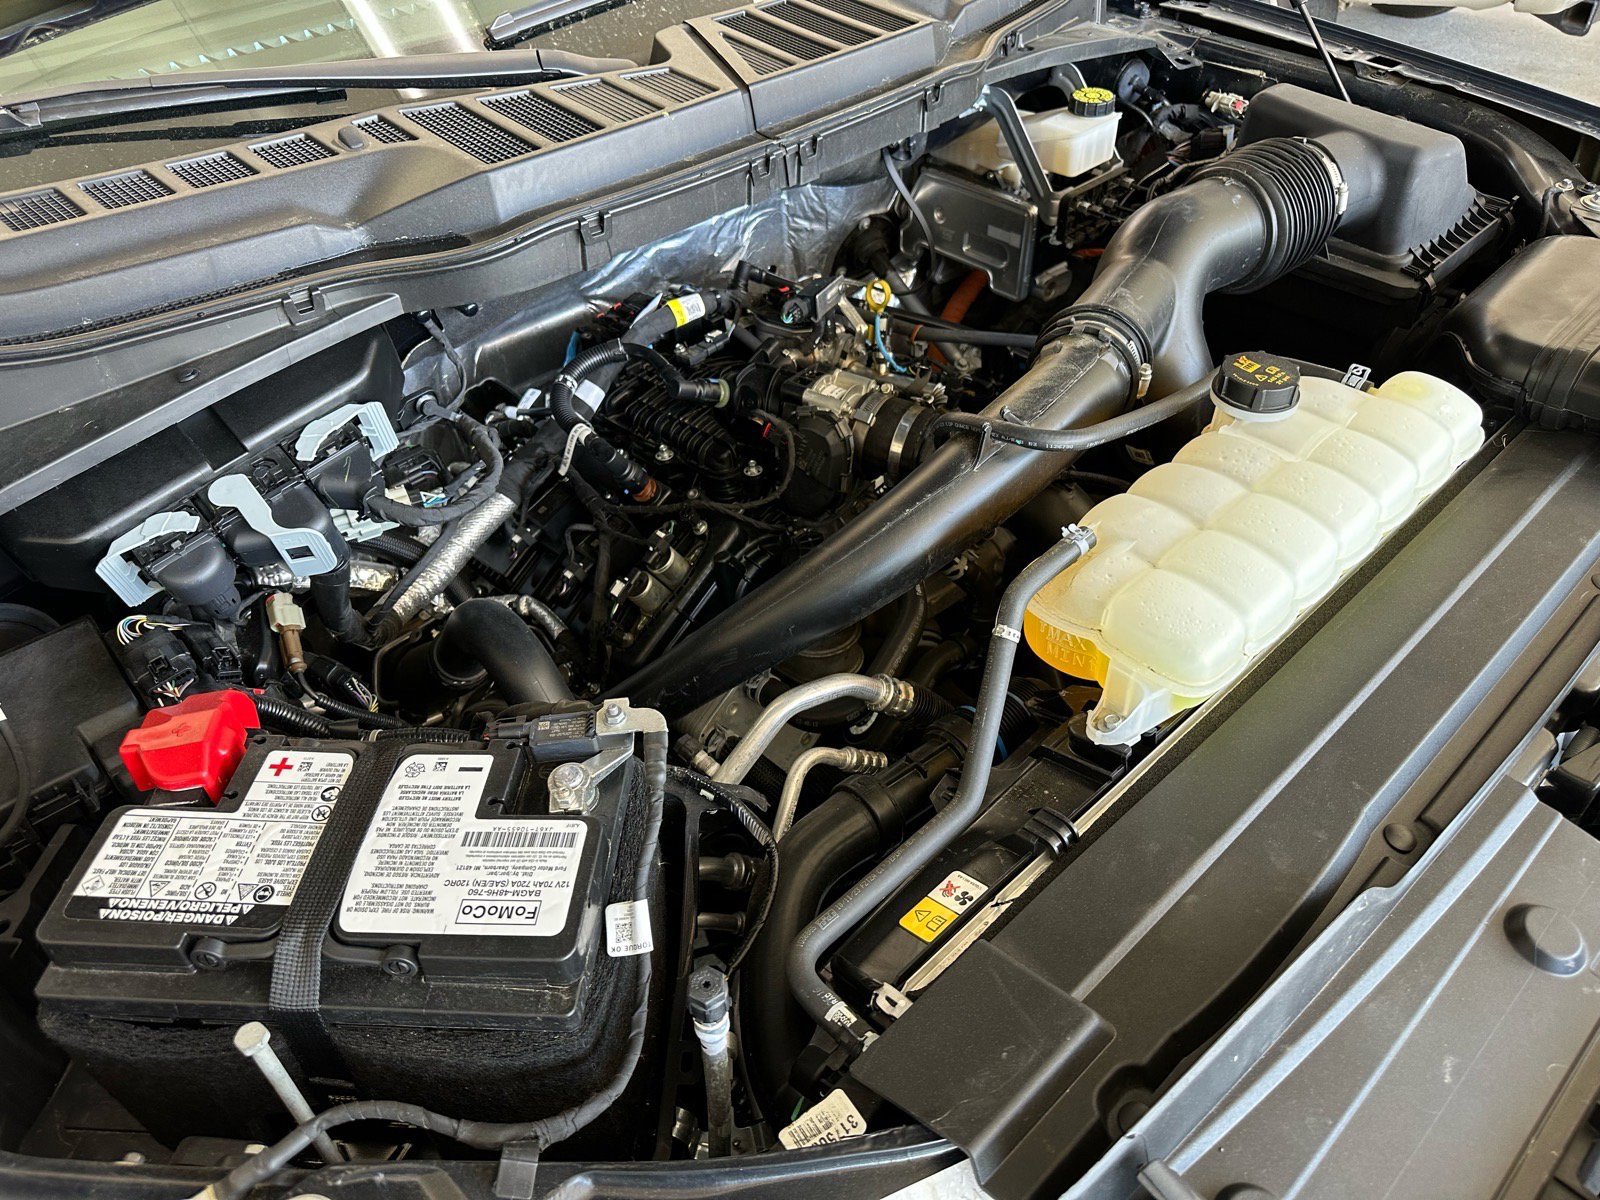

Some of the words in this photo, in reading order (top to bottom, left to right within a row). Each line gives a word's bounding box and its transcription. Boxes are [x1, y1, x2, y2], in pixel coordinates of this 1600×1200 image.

[1047, 642, 1085, 667] MIN
[472, 878, 510, 887] (SAE/EN)
[468, 889, 541, 897] BAGM-48H6-760
[119, 898, 242, 914] PELIGRO/VENENO
[462, 905, 538, 919] FoMoCo
[108, 909, 225, 924] DANGER/POISON
[624, 942, 651, 951] TORQUE
